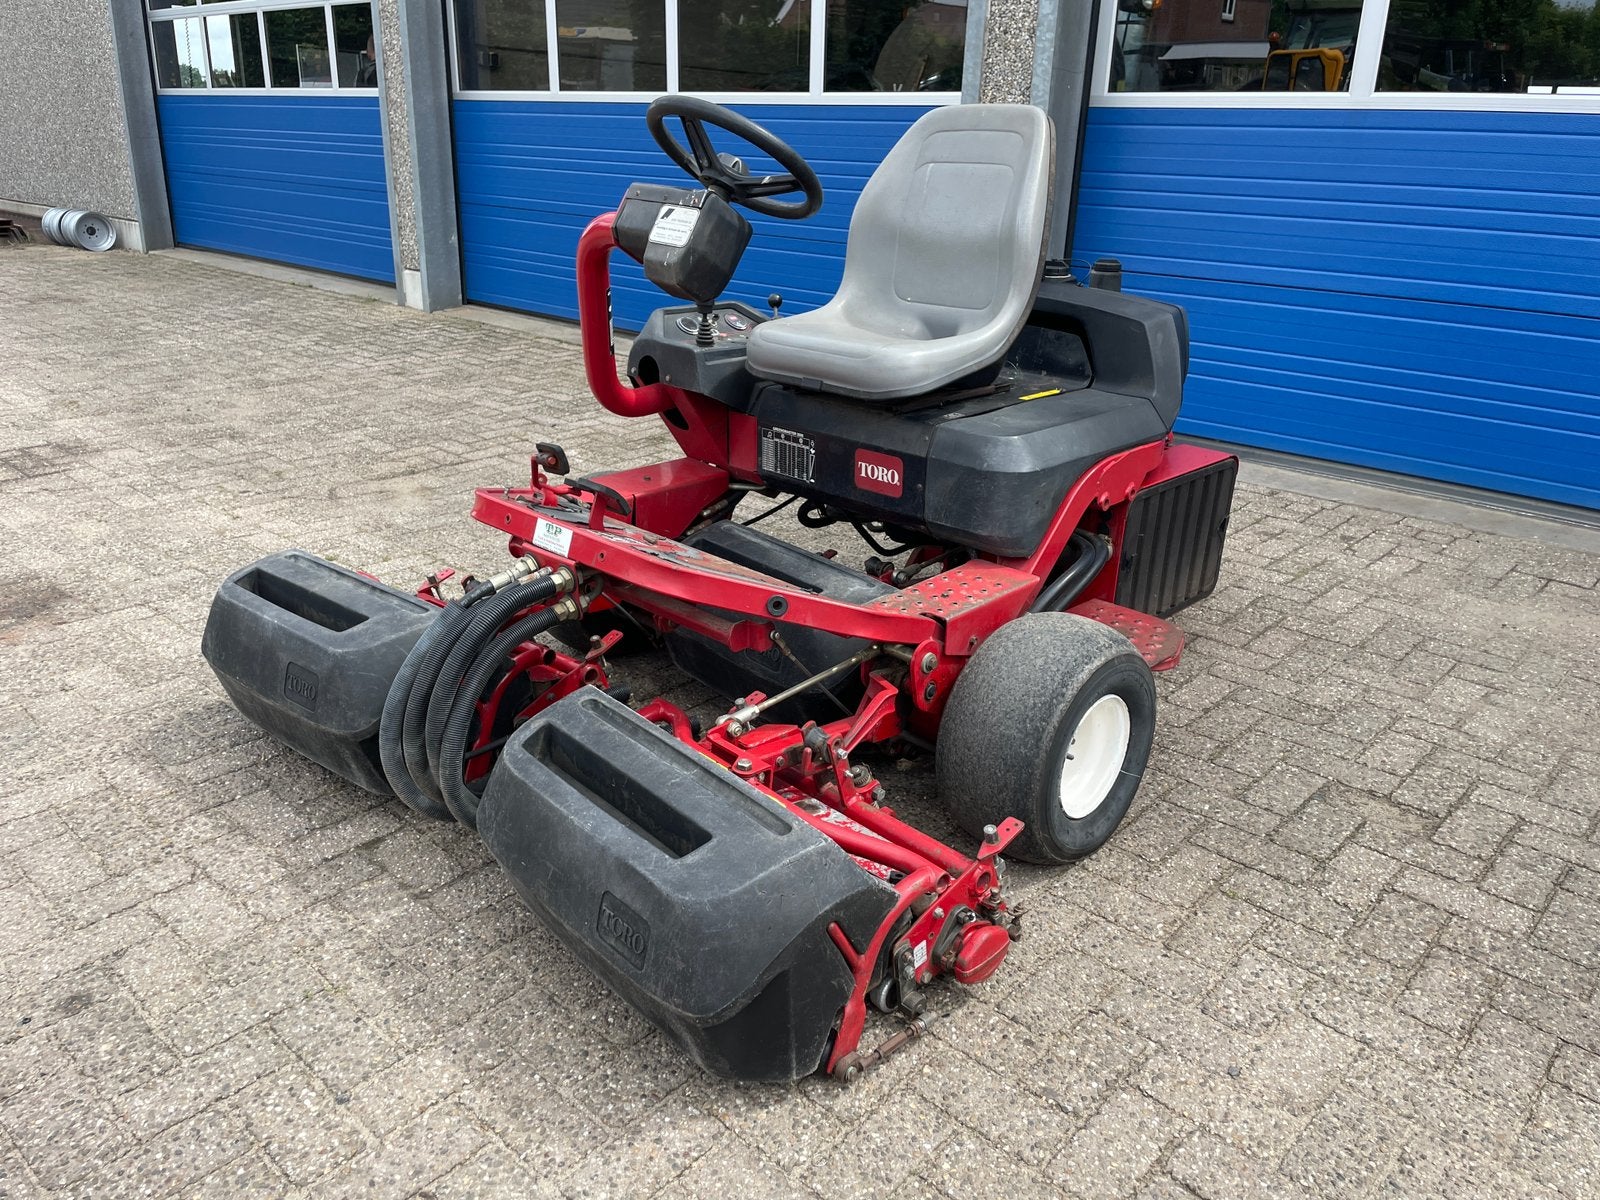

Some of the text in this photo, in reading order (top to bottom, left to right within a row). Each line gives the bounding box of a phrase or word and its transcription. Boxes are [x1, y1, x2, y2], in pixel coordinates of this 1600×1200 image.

[857, 461, 900, 485] TORO
[286, 673, 316, 701] TORO
[601, 904, 645, 954] TORO
